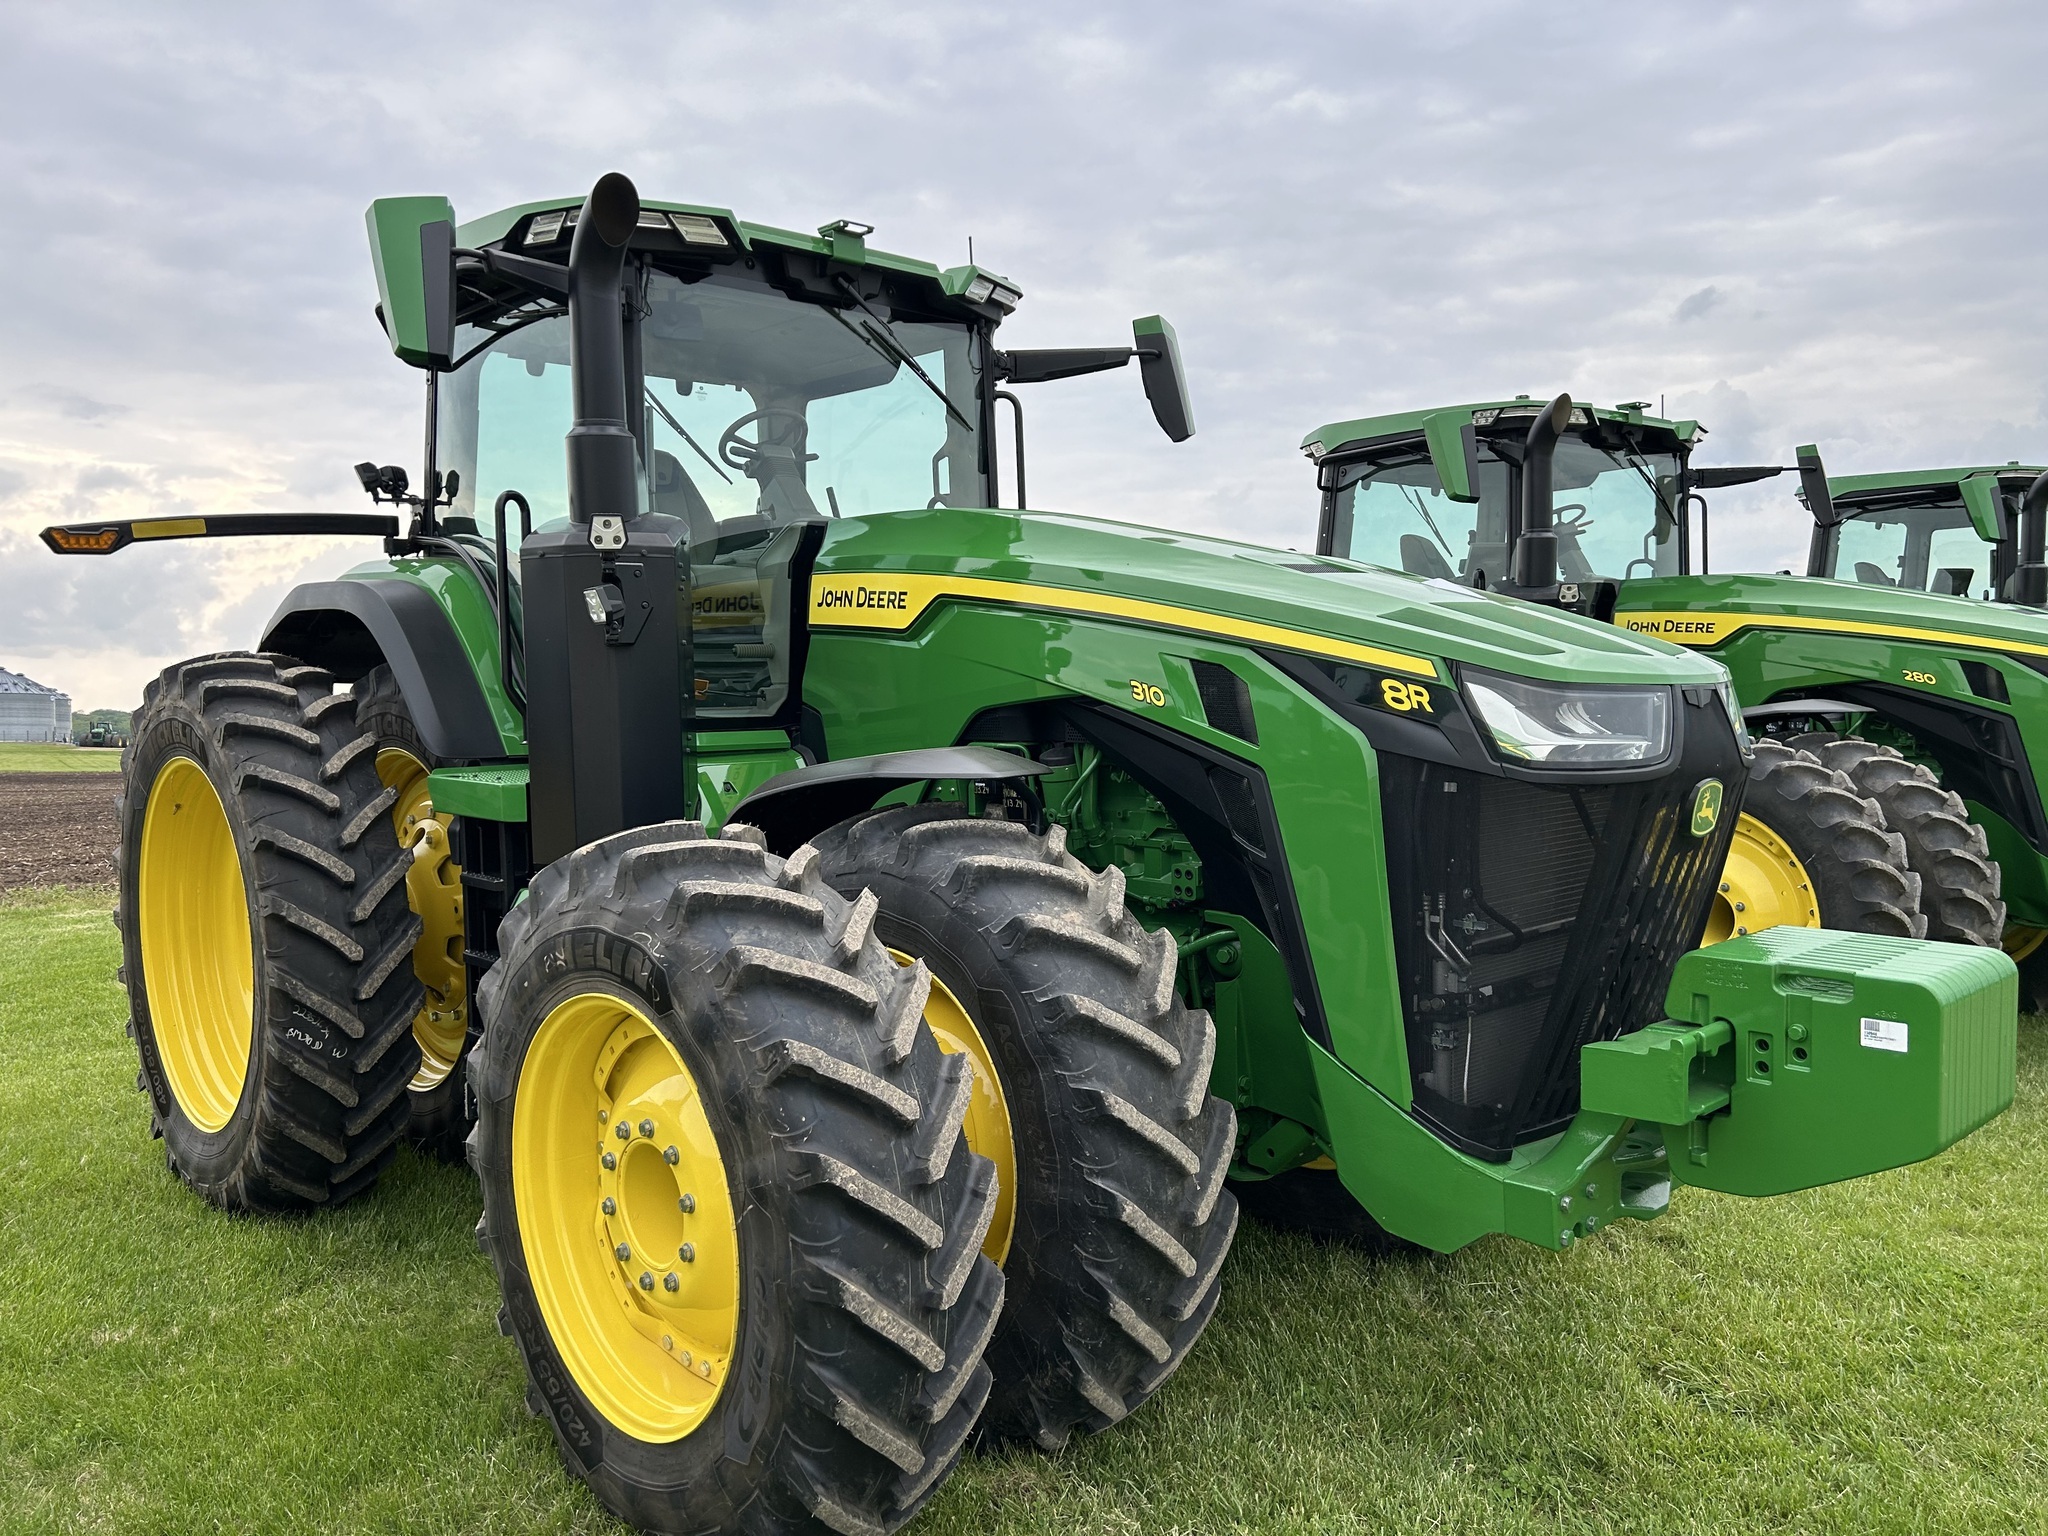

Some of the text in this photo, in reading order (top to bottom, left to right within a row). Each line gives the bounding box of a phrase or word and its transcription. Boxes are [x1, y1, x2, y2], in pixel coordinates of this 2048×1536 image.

[817, 586, 908, 610] JOHN DEERE
[1626, 619, 1715, 634] JOHN DEERE
[1902, 669, 1936, 685] 280
[1130, 679, 1166, 707] 310
[1380, 678, 1434, 713] 8R
[142, 1044, 167, 1104] 480/80
[510, 1289, 542, 1356] R34
[535, 1358, 592, 1447] 420/85
